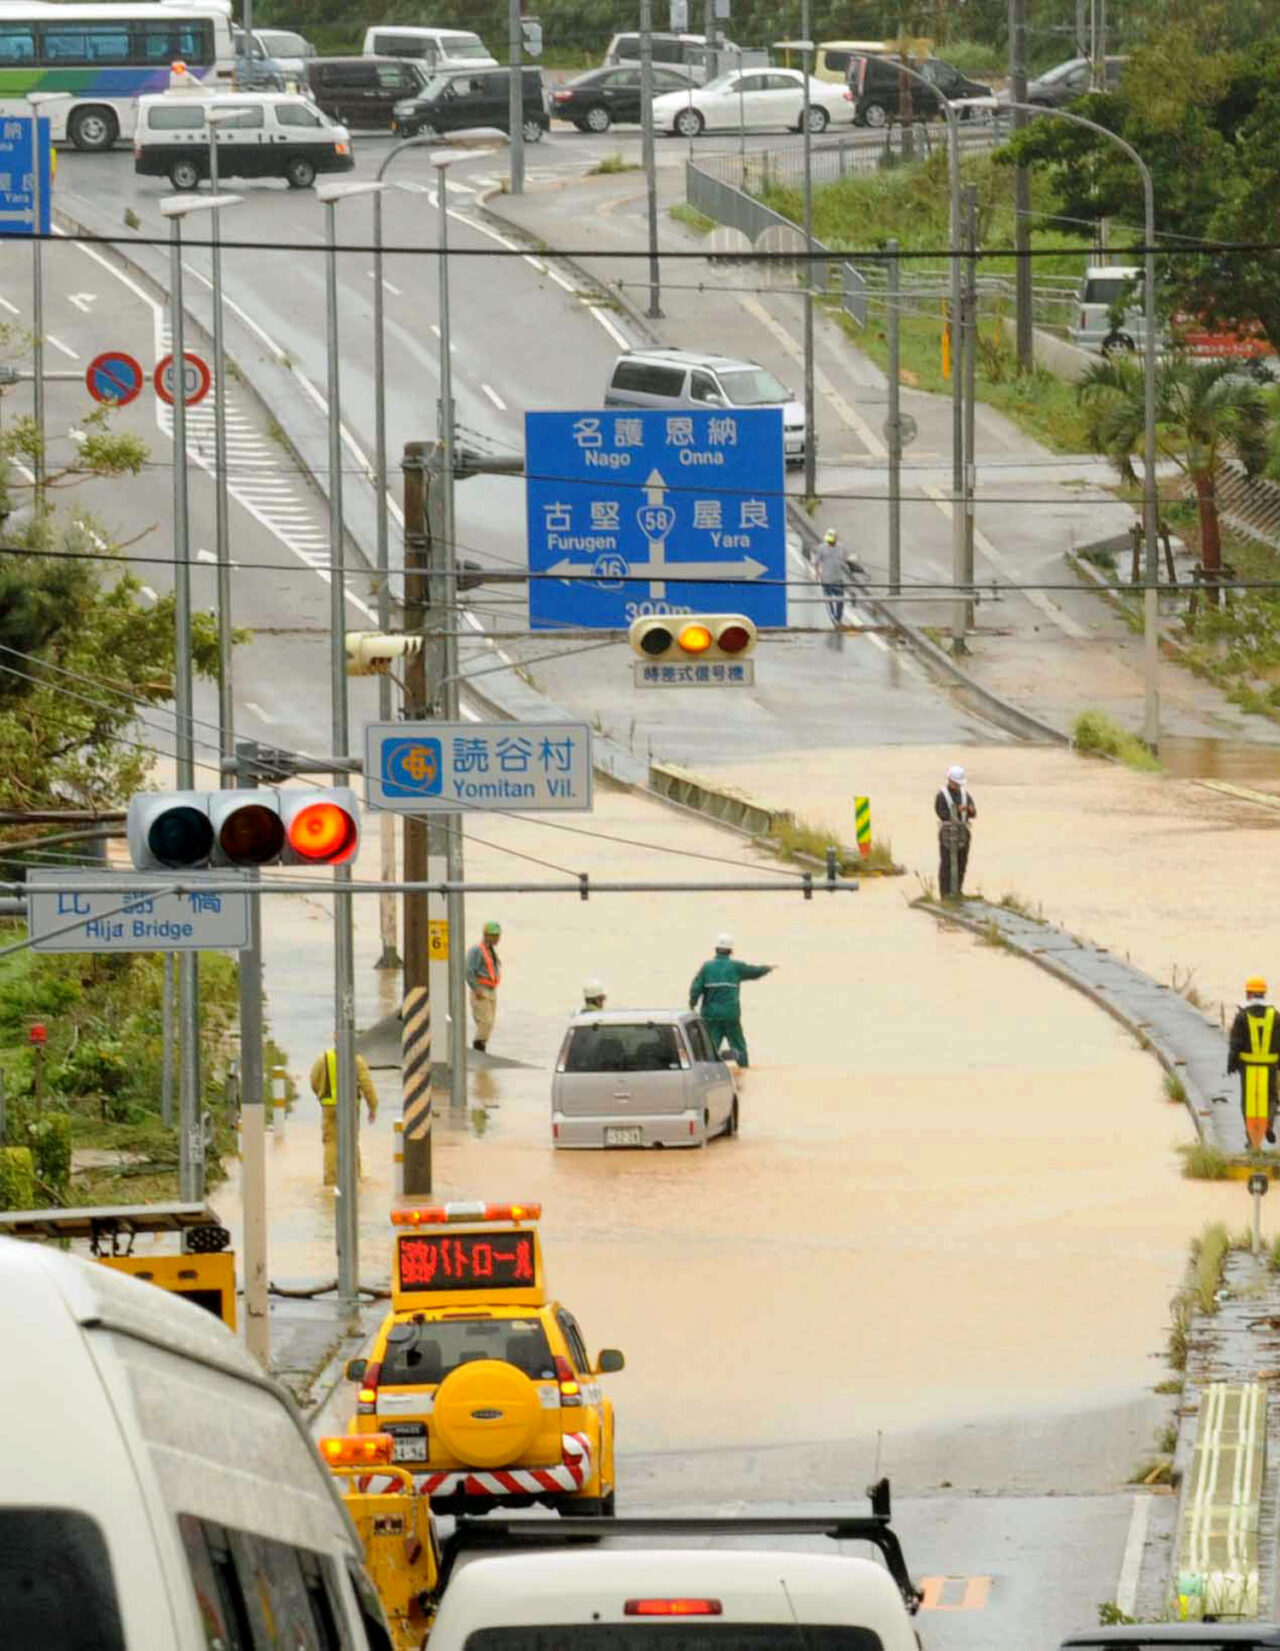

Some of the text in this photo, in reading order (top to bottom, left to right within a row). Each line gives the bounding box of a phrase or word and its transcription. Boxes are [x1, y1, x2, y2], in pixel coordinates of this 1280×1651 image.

[573, 416, 737, 447] 名護 恩納
[585, 449, 724, 469] Nago Onna
[543, 501, 620, 532] 古堅
[645, 513, 667, 524] 58
[693, 499, 769, 529] 屋良
[548, 535, 616, 552] Furugen
[711, 532, 750, 548] Yara
[601, 562, 621, 576] 16
[643, 665, 744, 682] 時差式信号機
[453, 736, 574, 773] 読谷村
[454, 779, 576, 798] Yomitan Vil.
[86, 919, 194, 942] Hija Bridge
